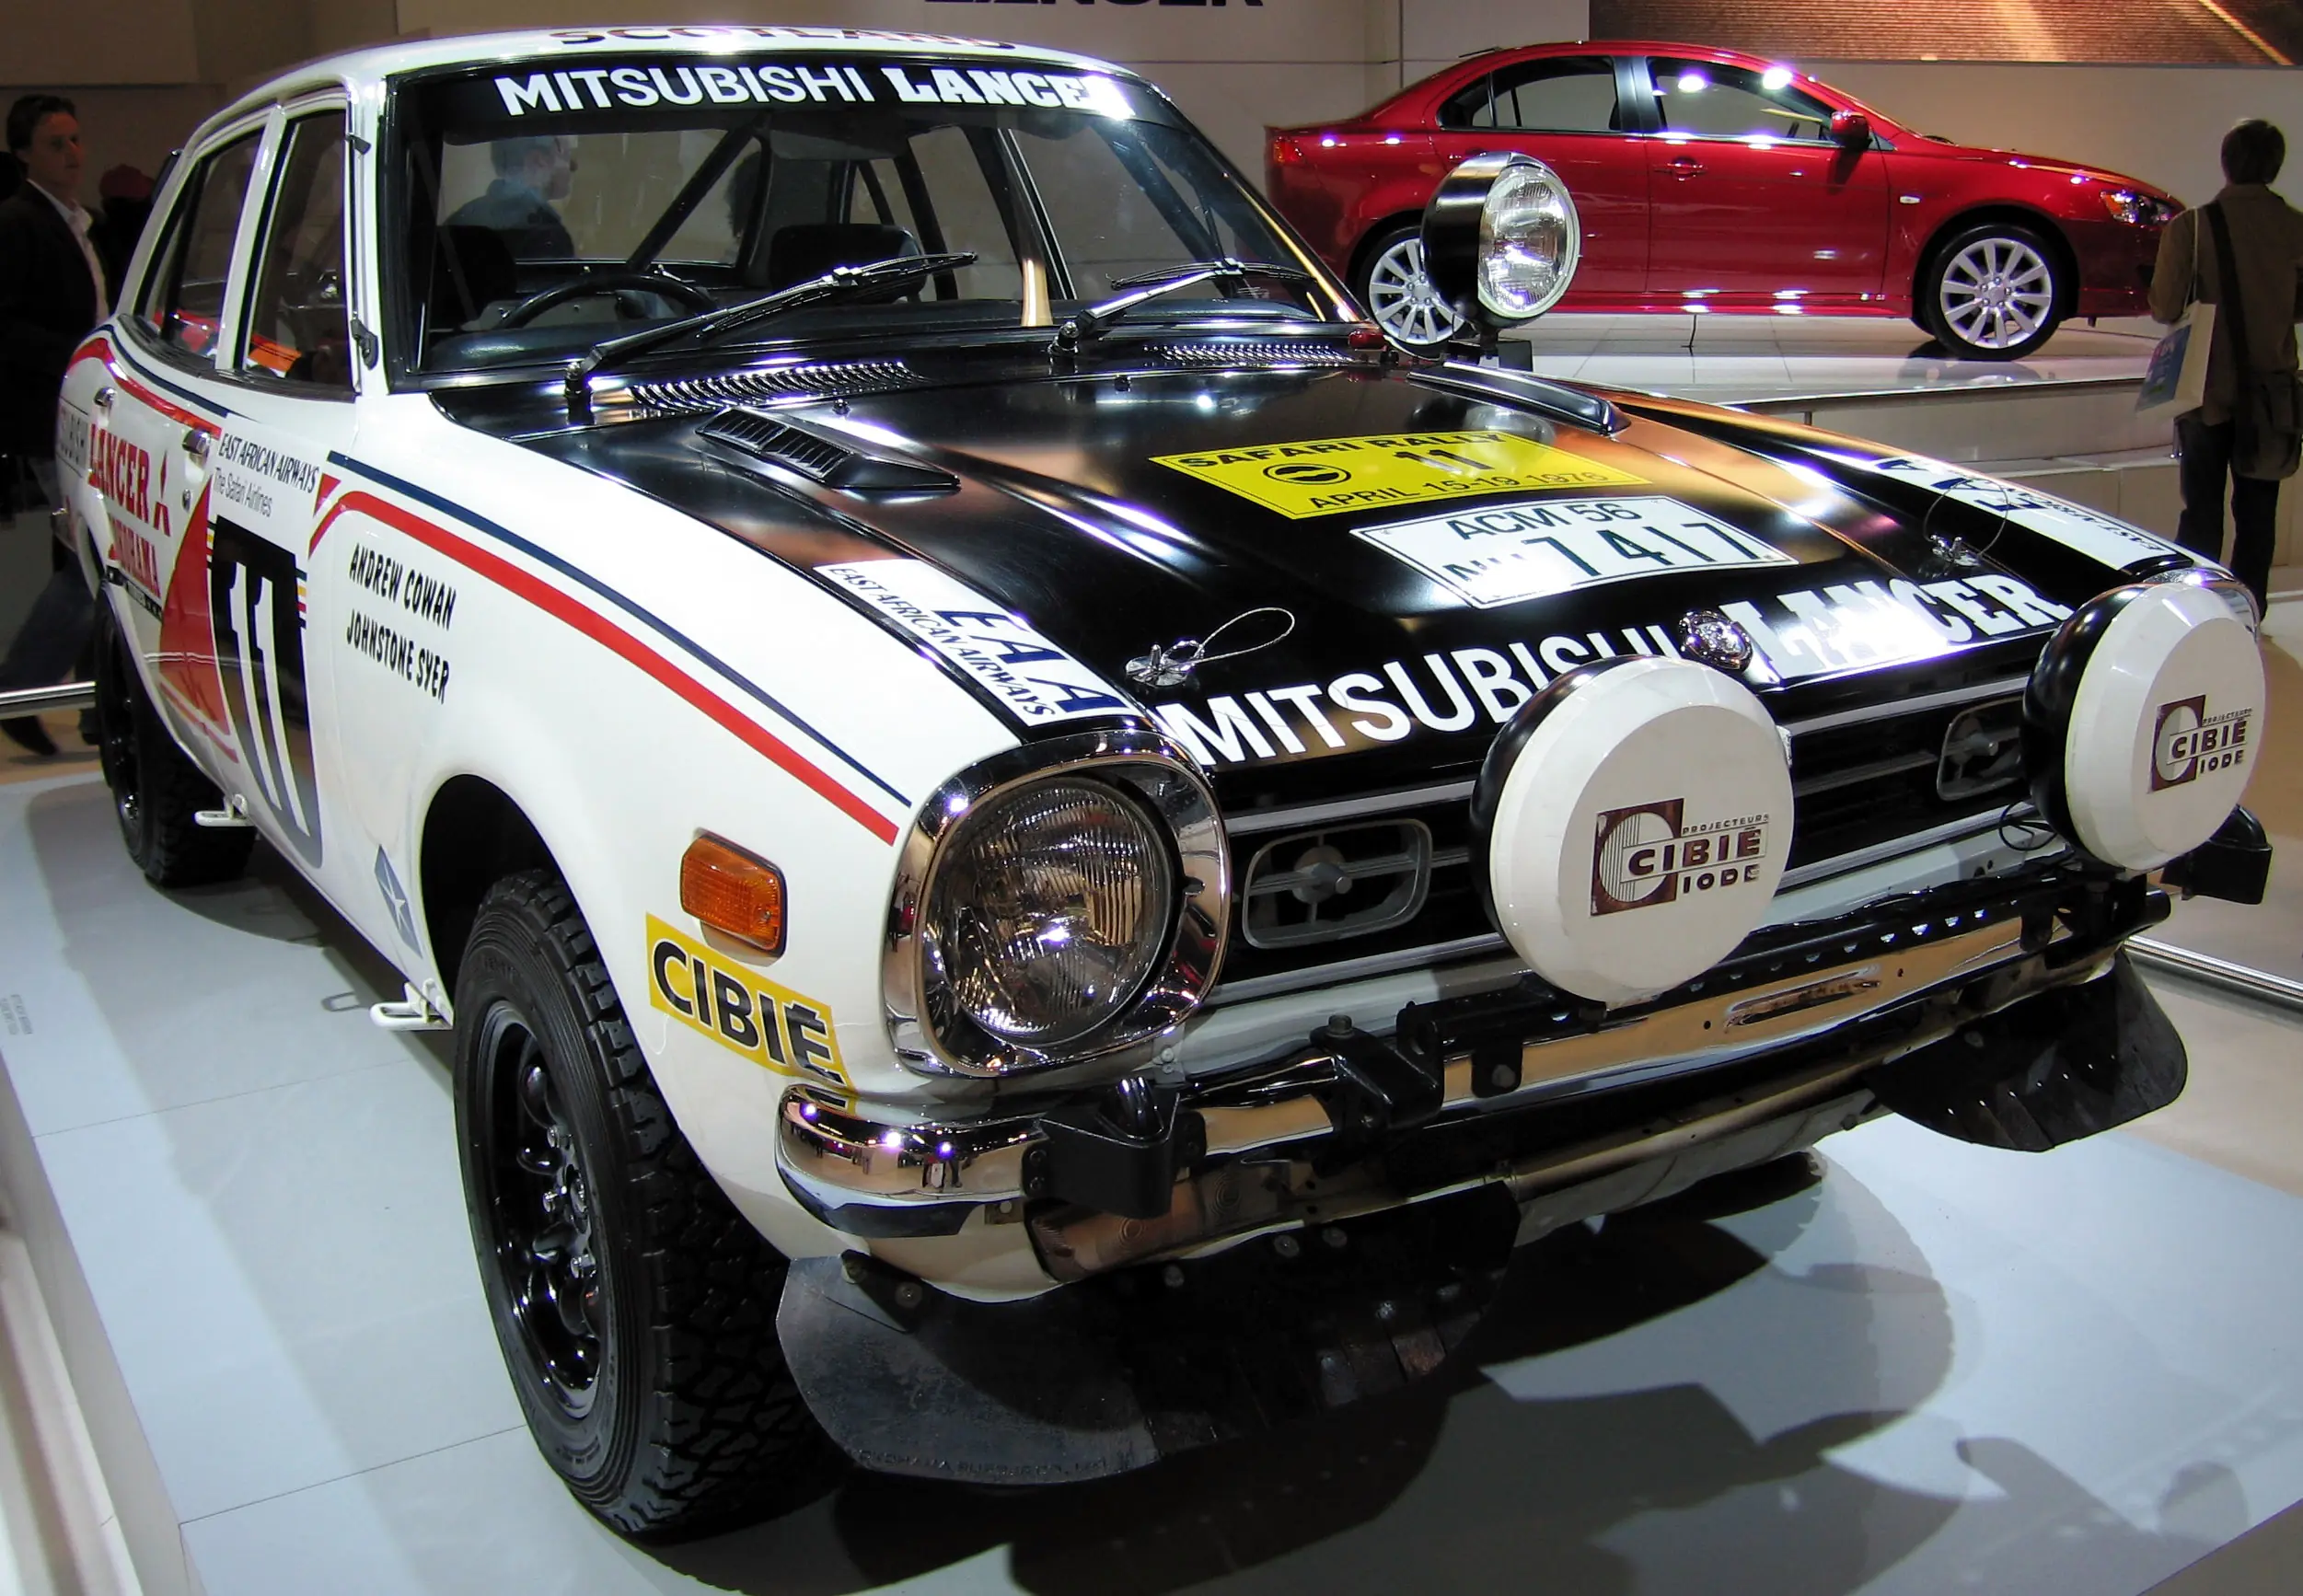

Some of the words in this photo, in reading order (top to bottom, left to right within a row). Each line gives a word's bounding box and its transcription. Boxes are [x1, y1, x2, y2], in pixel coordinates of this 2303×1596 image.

[494, 66, 875, 116] MITSUBISHI
[881, 68, 1135, 121] LANCE
[88, 423, 149, 524] LANCER
[218, 433, 243, 463] EAST
[239, 441, 278, 480] AFRICAN
[275, 455, 319, 493] AIRWAYS
[1178, 442, 1364, 467] SAFARI
[1364, 434, 1507, 448] RALLY
[1394, 449, 1495, 475] 11
[225, 472, 246, 503] Safari
[243, 481, 272, 517] Airlines
[1308, 487, 1421, 508] APRIL
[1423, 476, 1520, 492] 15-19
[1446, 507, 1572, 540] ACM
[1564, 503, 1643, 522] 56
[1522, 522, 1761, 577] 7417
[349, 542, 403, 603] ANDREW
[403, 569, 457, 631] COWAN
[346, 608, 414, 681] JOHNSTONE
[416, 648, 449, 705] SYER
[827, 567, 888, 593] EAST
[874, 594, 968, 644] AFRICAN
[948, 646, 1056, 716] AIRWAYS
[229, 561, 311, 837] 11
[2200, 750, 2244, 774] IODE
[1682, 814, 1769, 835] PROJECTEURS
[1683, 863, 1760, 895] IODE
